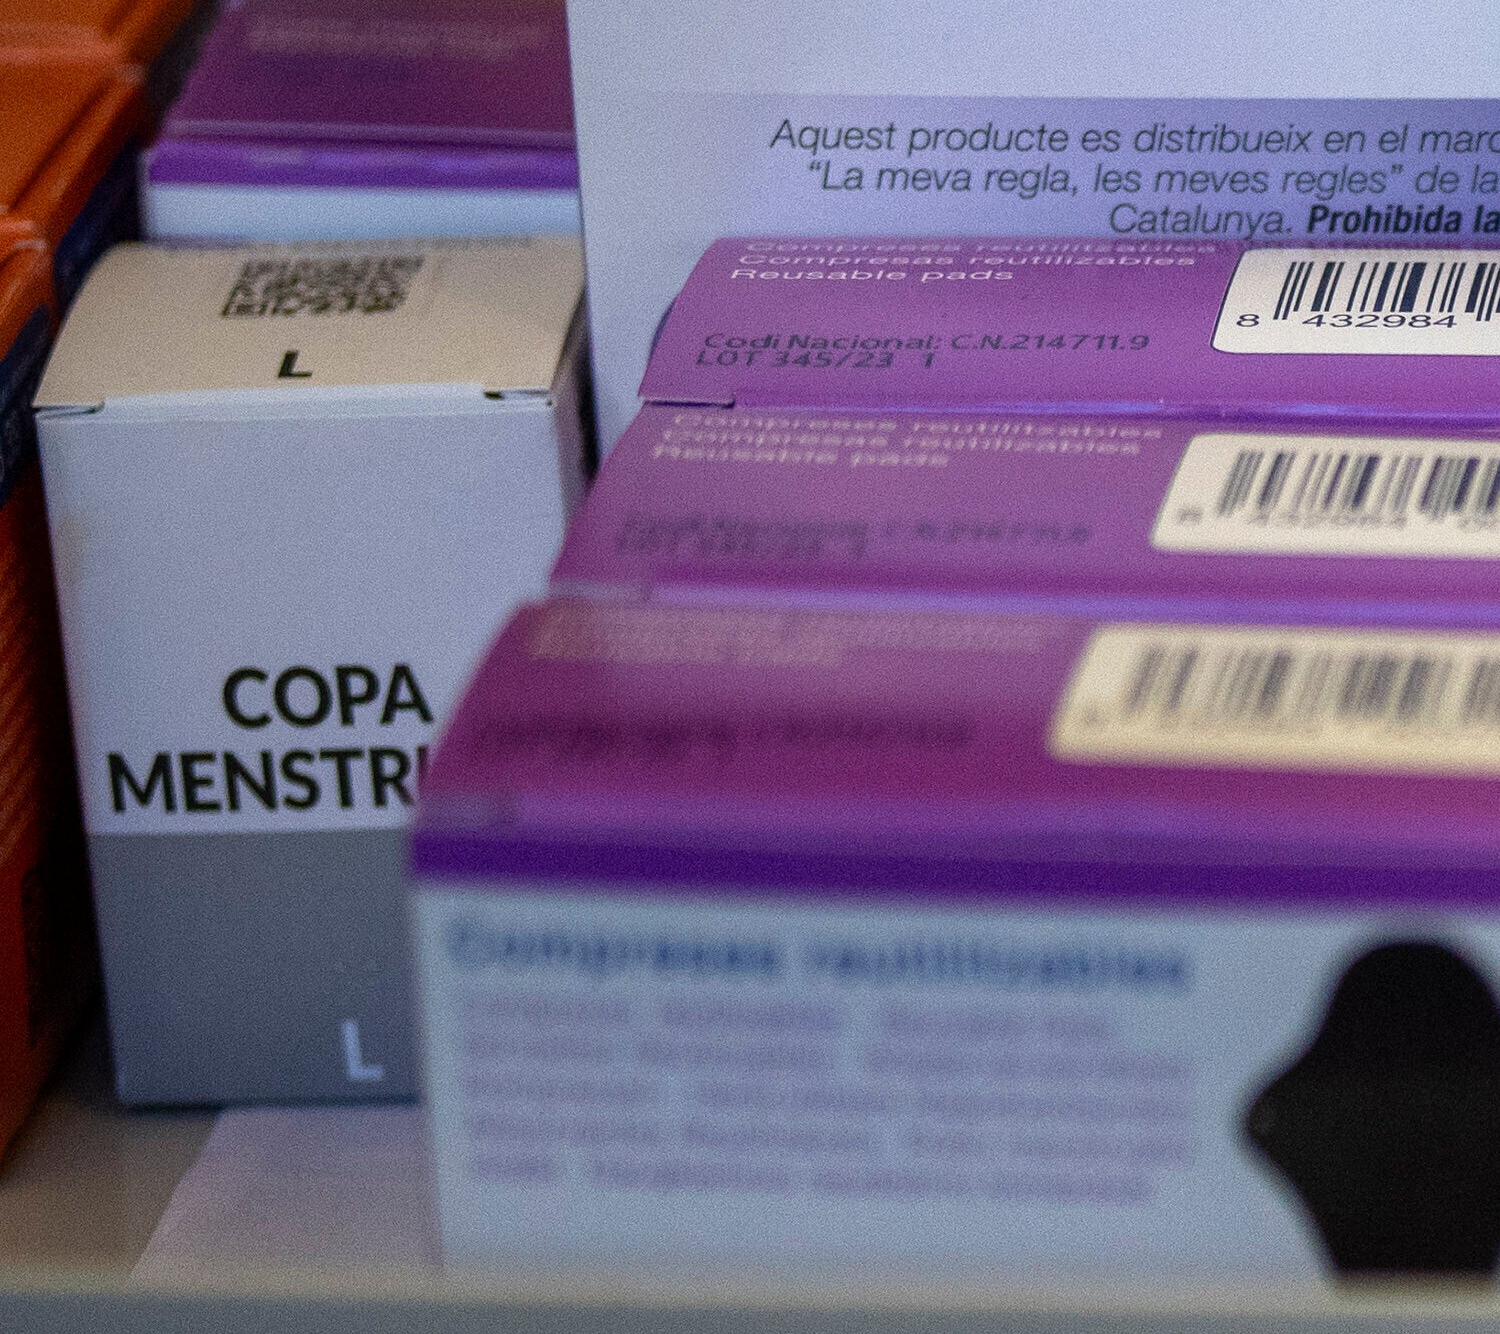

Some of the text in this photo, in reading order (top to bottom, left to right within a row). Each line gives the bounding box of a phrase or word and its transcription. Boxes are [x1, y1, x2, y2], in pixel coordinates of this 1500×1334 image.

[768, 118, 897, 155] Aquest
[906, 122, 1070, 157] producte
[1081, 130, 1122, 154] es
[1134, 123, 1311, 154] distribueix
[1323, 131, 1366, 154] en
[1378, 124, 1408, 154] el
[877, 168, 971, 192] meva
[984, 163, 1078, 198] regla,
[1093, 164, 1141, 193] les
[1152, 169, 1269, 194] meves
[1414, 164, 1460, 194] de
[1470, 164, 1500, 194] la
[1107, 202, 1293, 240] Catalunya.
[1306, 204, 1462, 235] Prohibida
[1473, 205, 1500, 234] la
[730, 268, 1014, 285] Reusable pads
[738, 253, 1196, 268] Compresas reutilizables
[1235, 313, 1261, 330] 8
[1300, 313, 1459, 330] 432984
[703, 332, 781, 350] Codi
[786, 333, 942, 351] Nacional:
[277, 350, 313, 379] L
[695, 350, 766, 367] LOT
[771, 350, 895, 369] 345/23
[221, 663, 434, 729] COPA
[107, 745, 428, 813] MENSTR
[340, 1020, 384, 1081] L
